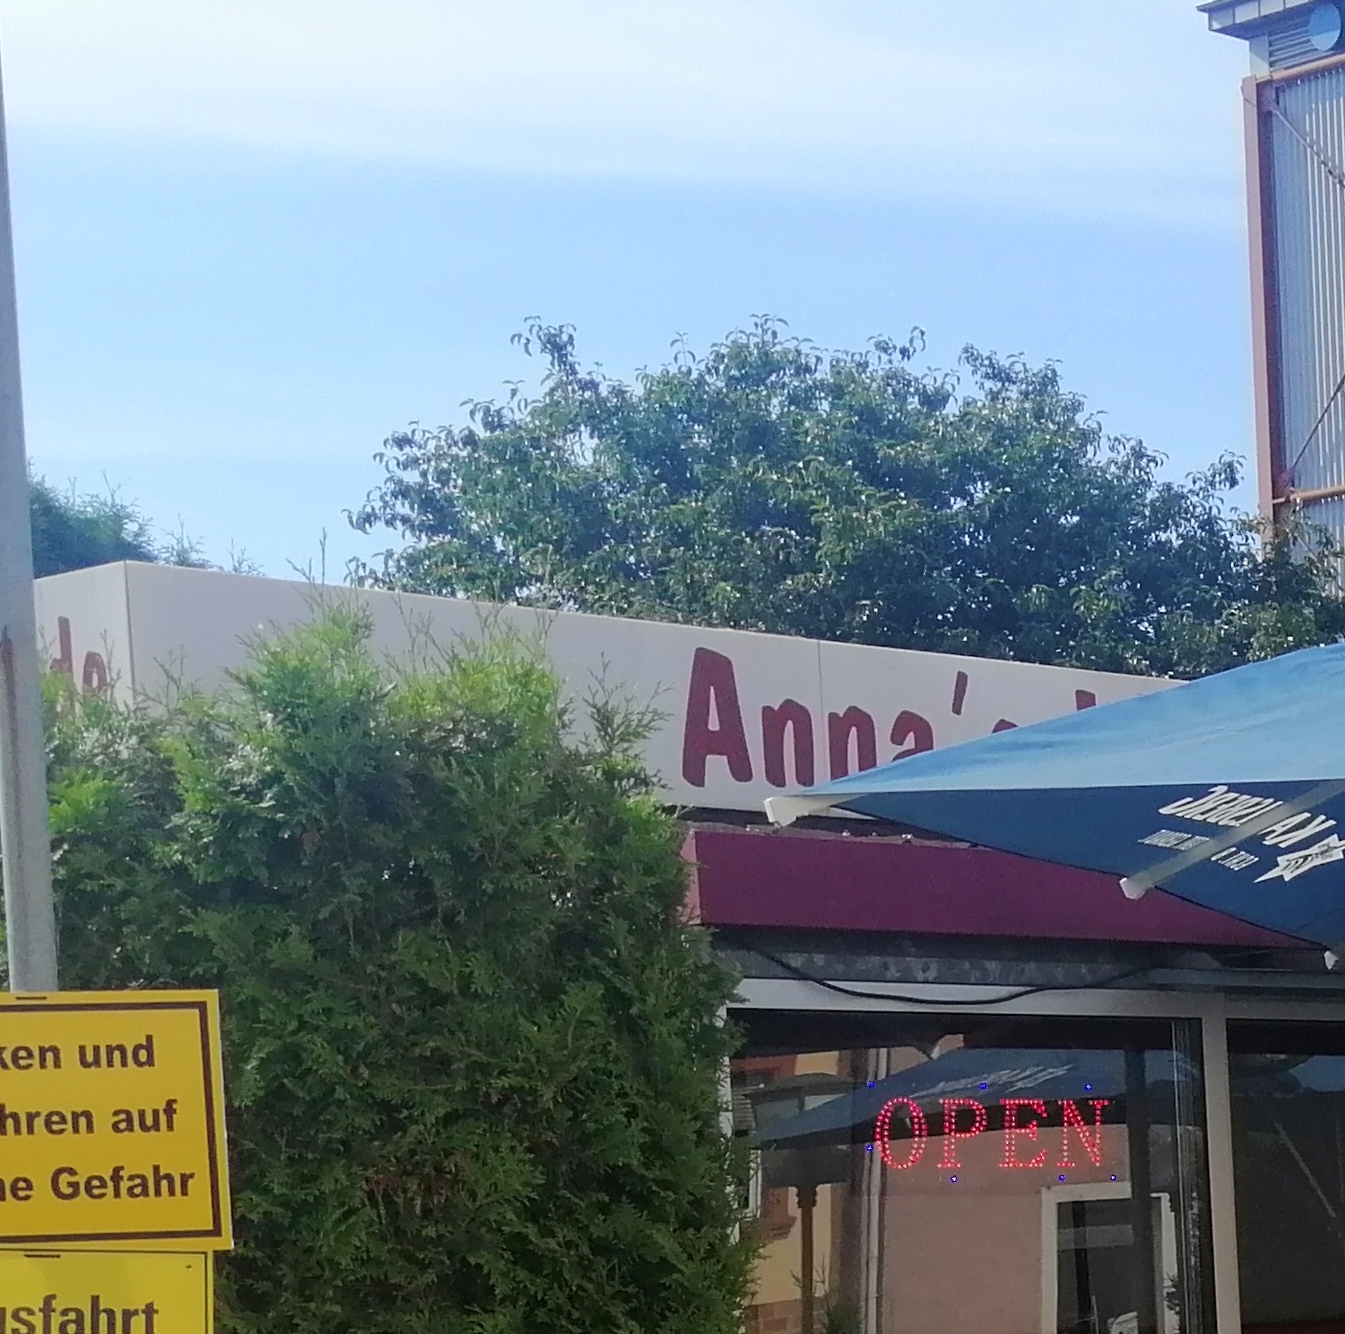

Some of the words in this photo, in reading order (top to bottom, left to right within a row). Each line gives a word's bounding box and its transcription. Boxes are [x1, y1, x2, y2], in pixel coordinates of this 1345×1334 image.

[682, 646, 1019, 788] Anna'
[78, 1034, 155, 1069] und
[0, 1103, 95, 1136] hren
[111, 1099, 178, 1134] auf
[873, 1095, 1110, 1170] OPEN
[0, 1175, 34, 1202] e
[50, 1164, 196, 1202] Gefahr
